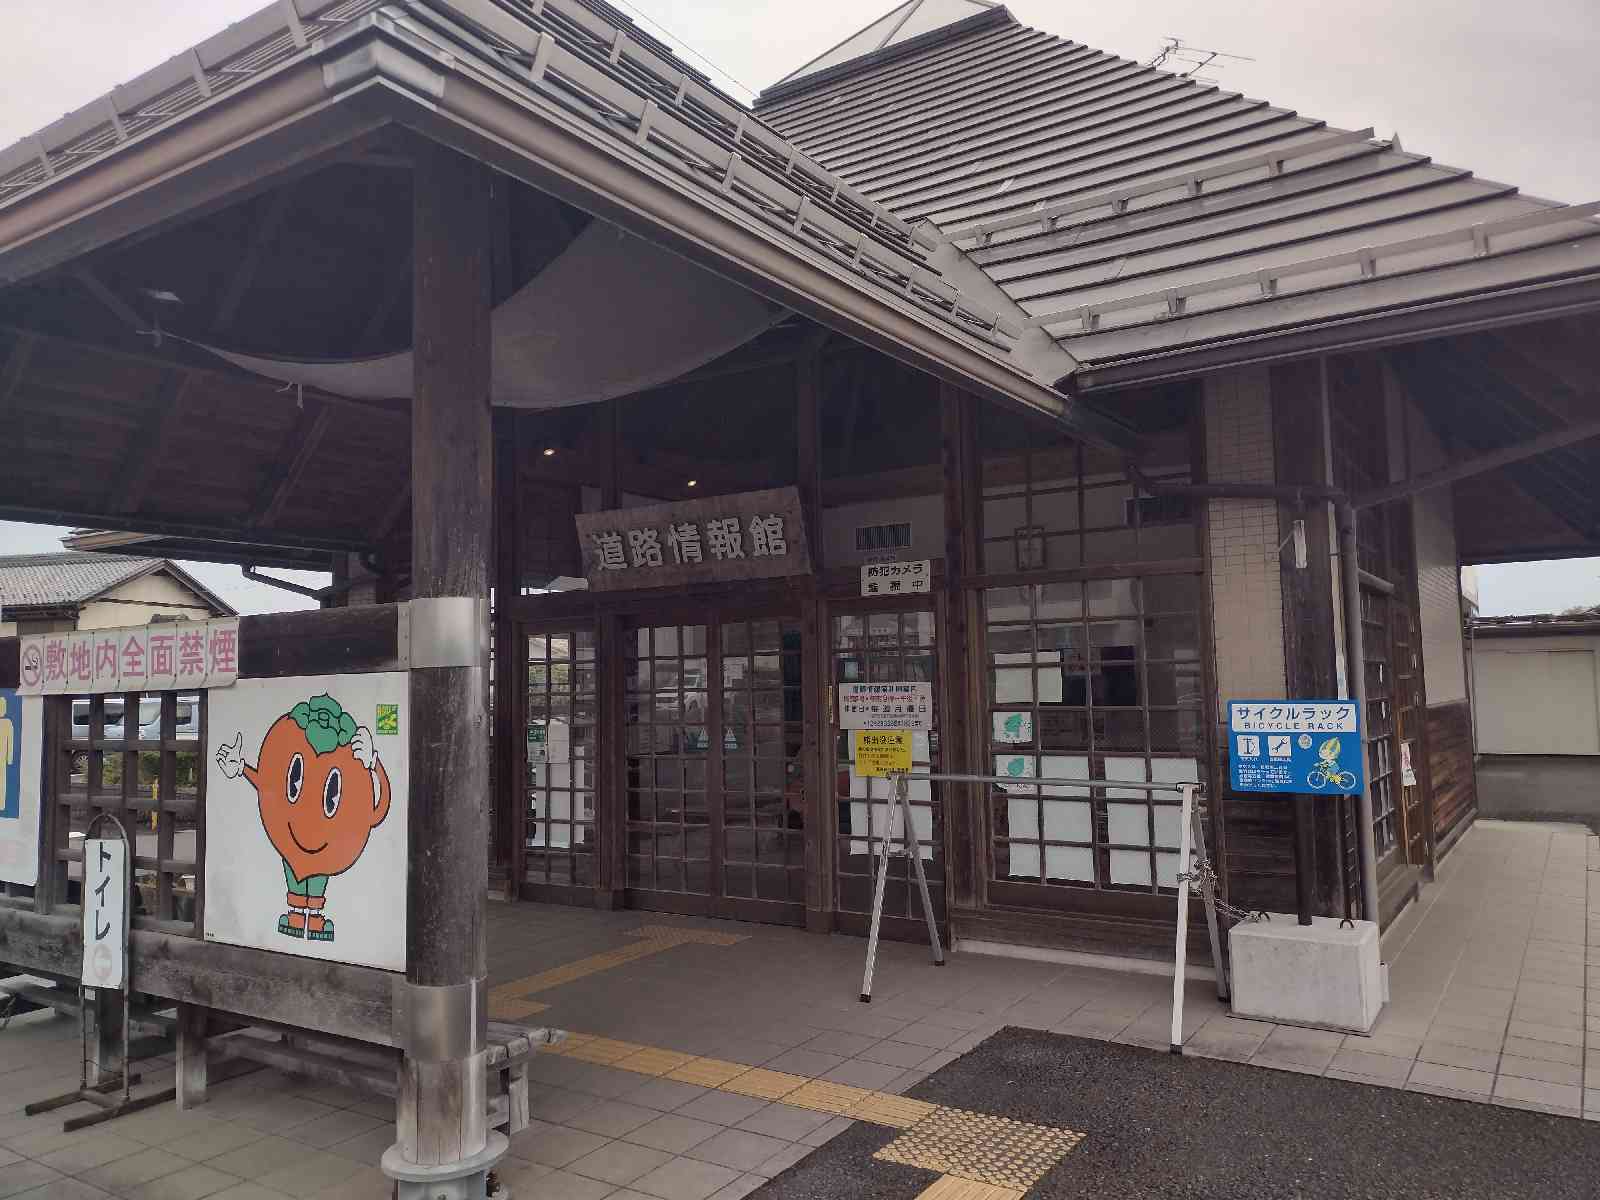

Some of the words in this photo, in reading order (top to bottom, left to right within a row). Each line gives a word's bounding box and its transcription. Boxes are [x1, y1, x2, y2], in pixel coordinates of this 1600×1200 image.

[593, 513, 786, 570] 道路情報館
[867, 563, 923, 577] 防犯カメラ
[45, 629, 237, 680] 敷地内全面禁煙
[1237, 707, 1350, 720] サイクルラック
[1244, 722, 1300, 730] BICYCLE
[1307, 722, 1344, 730] RACK
[94, 841, 111, 941] トイレ
